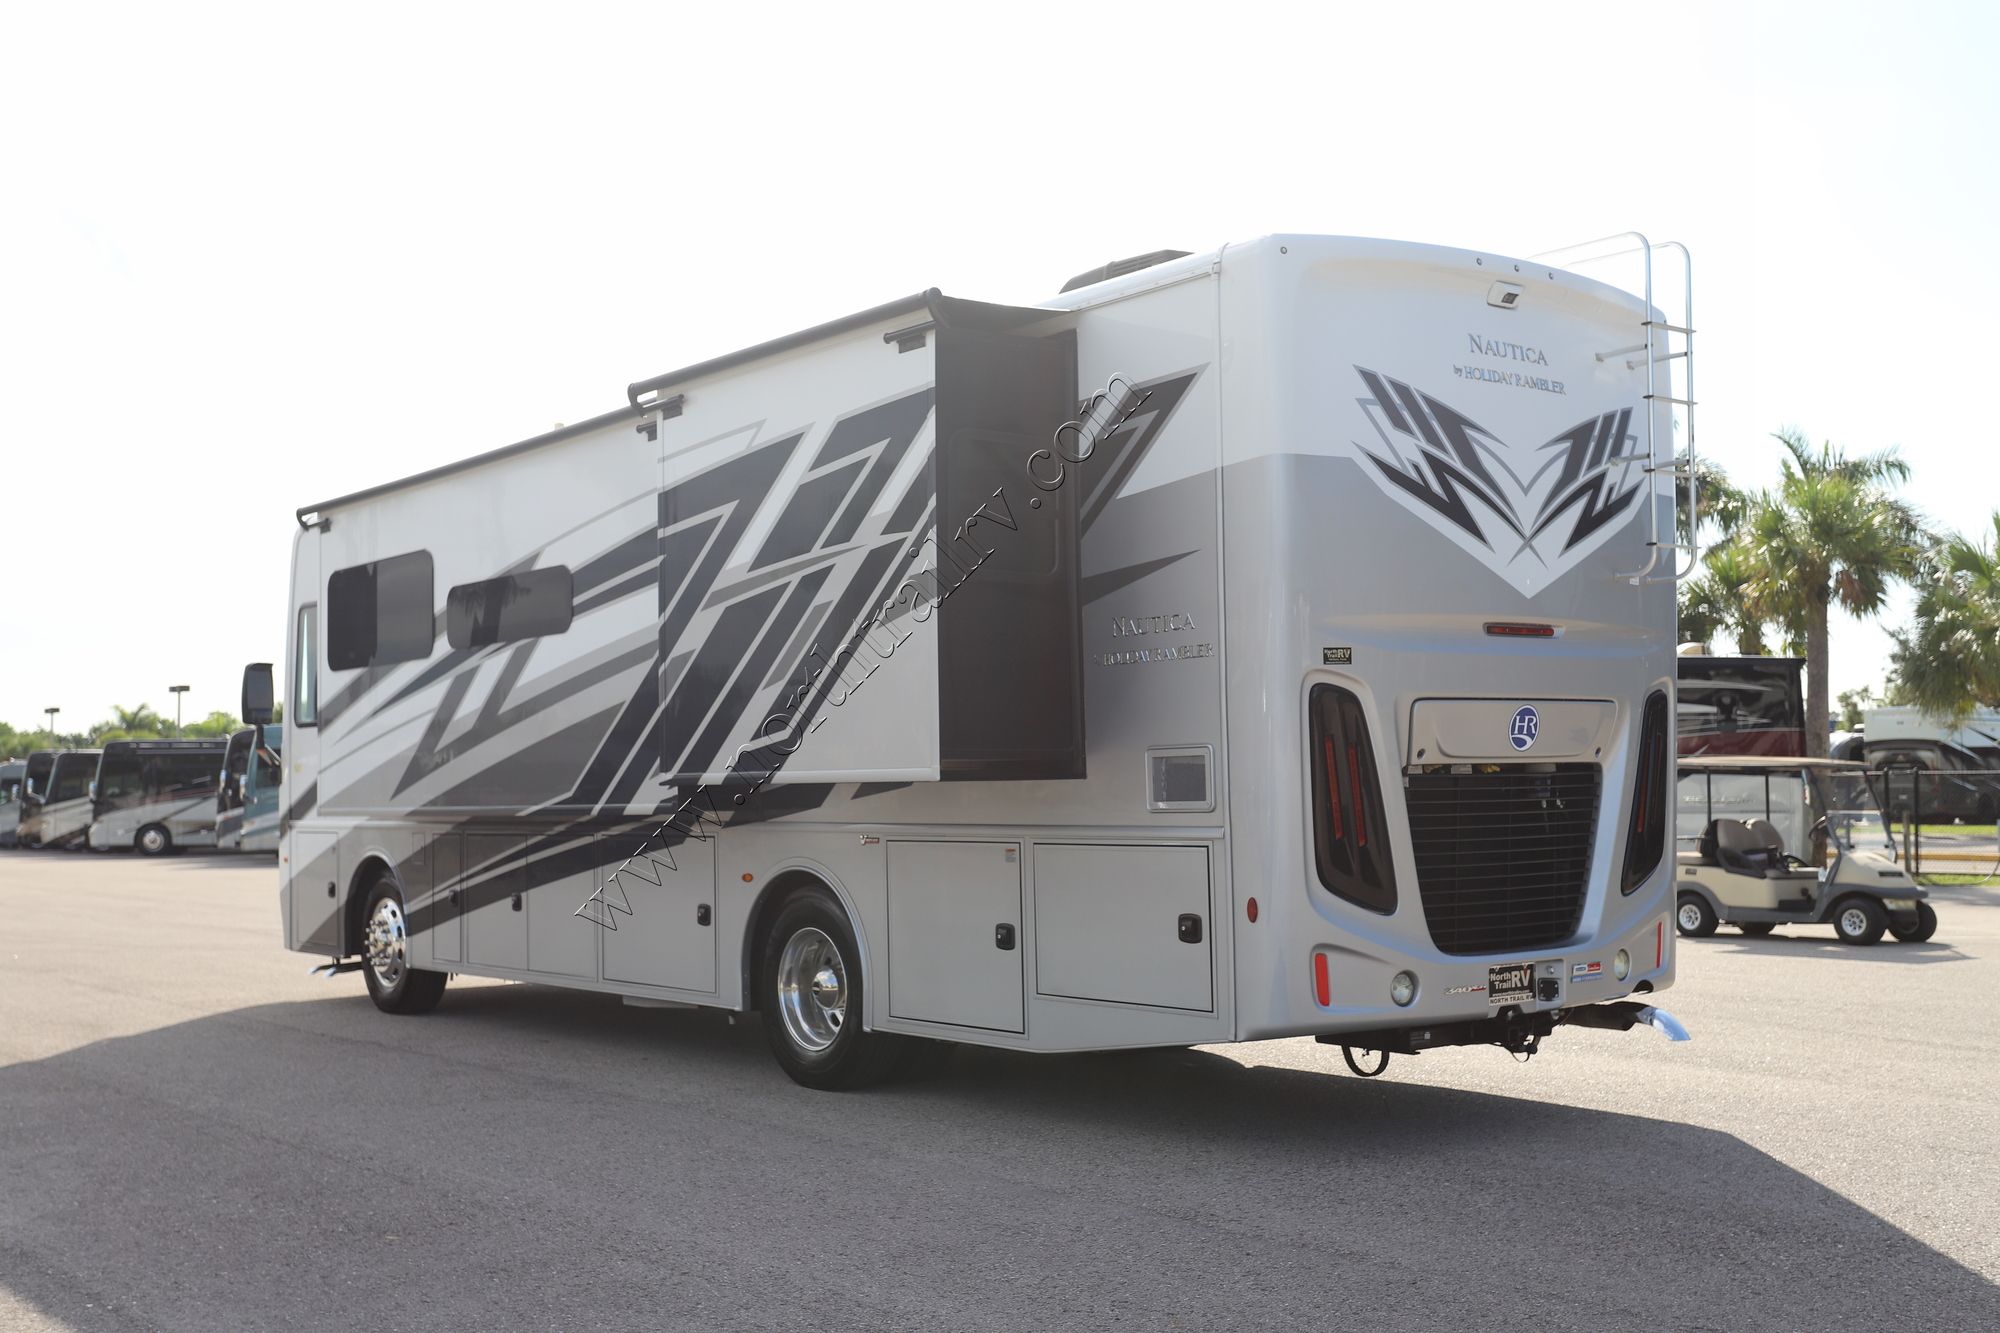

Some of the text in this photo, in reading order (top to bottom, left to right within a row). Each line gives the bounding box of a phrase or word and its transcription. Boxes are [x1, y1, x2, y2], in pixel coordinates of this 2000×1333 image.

[1468, 333, 1549, 366] NAUTICA
[1112, 612, 1197, 637] NAUTICA
[1513, 715, 1537, 734] HR
[1490, 972, 1511, 981] North
[1494, 980, 1511, 989] Trail
[1510, 969, 1531, 988] RV
[1489, 996, 1509, 1004] NORTH
